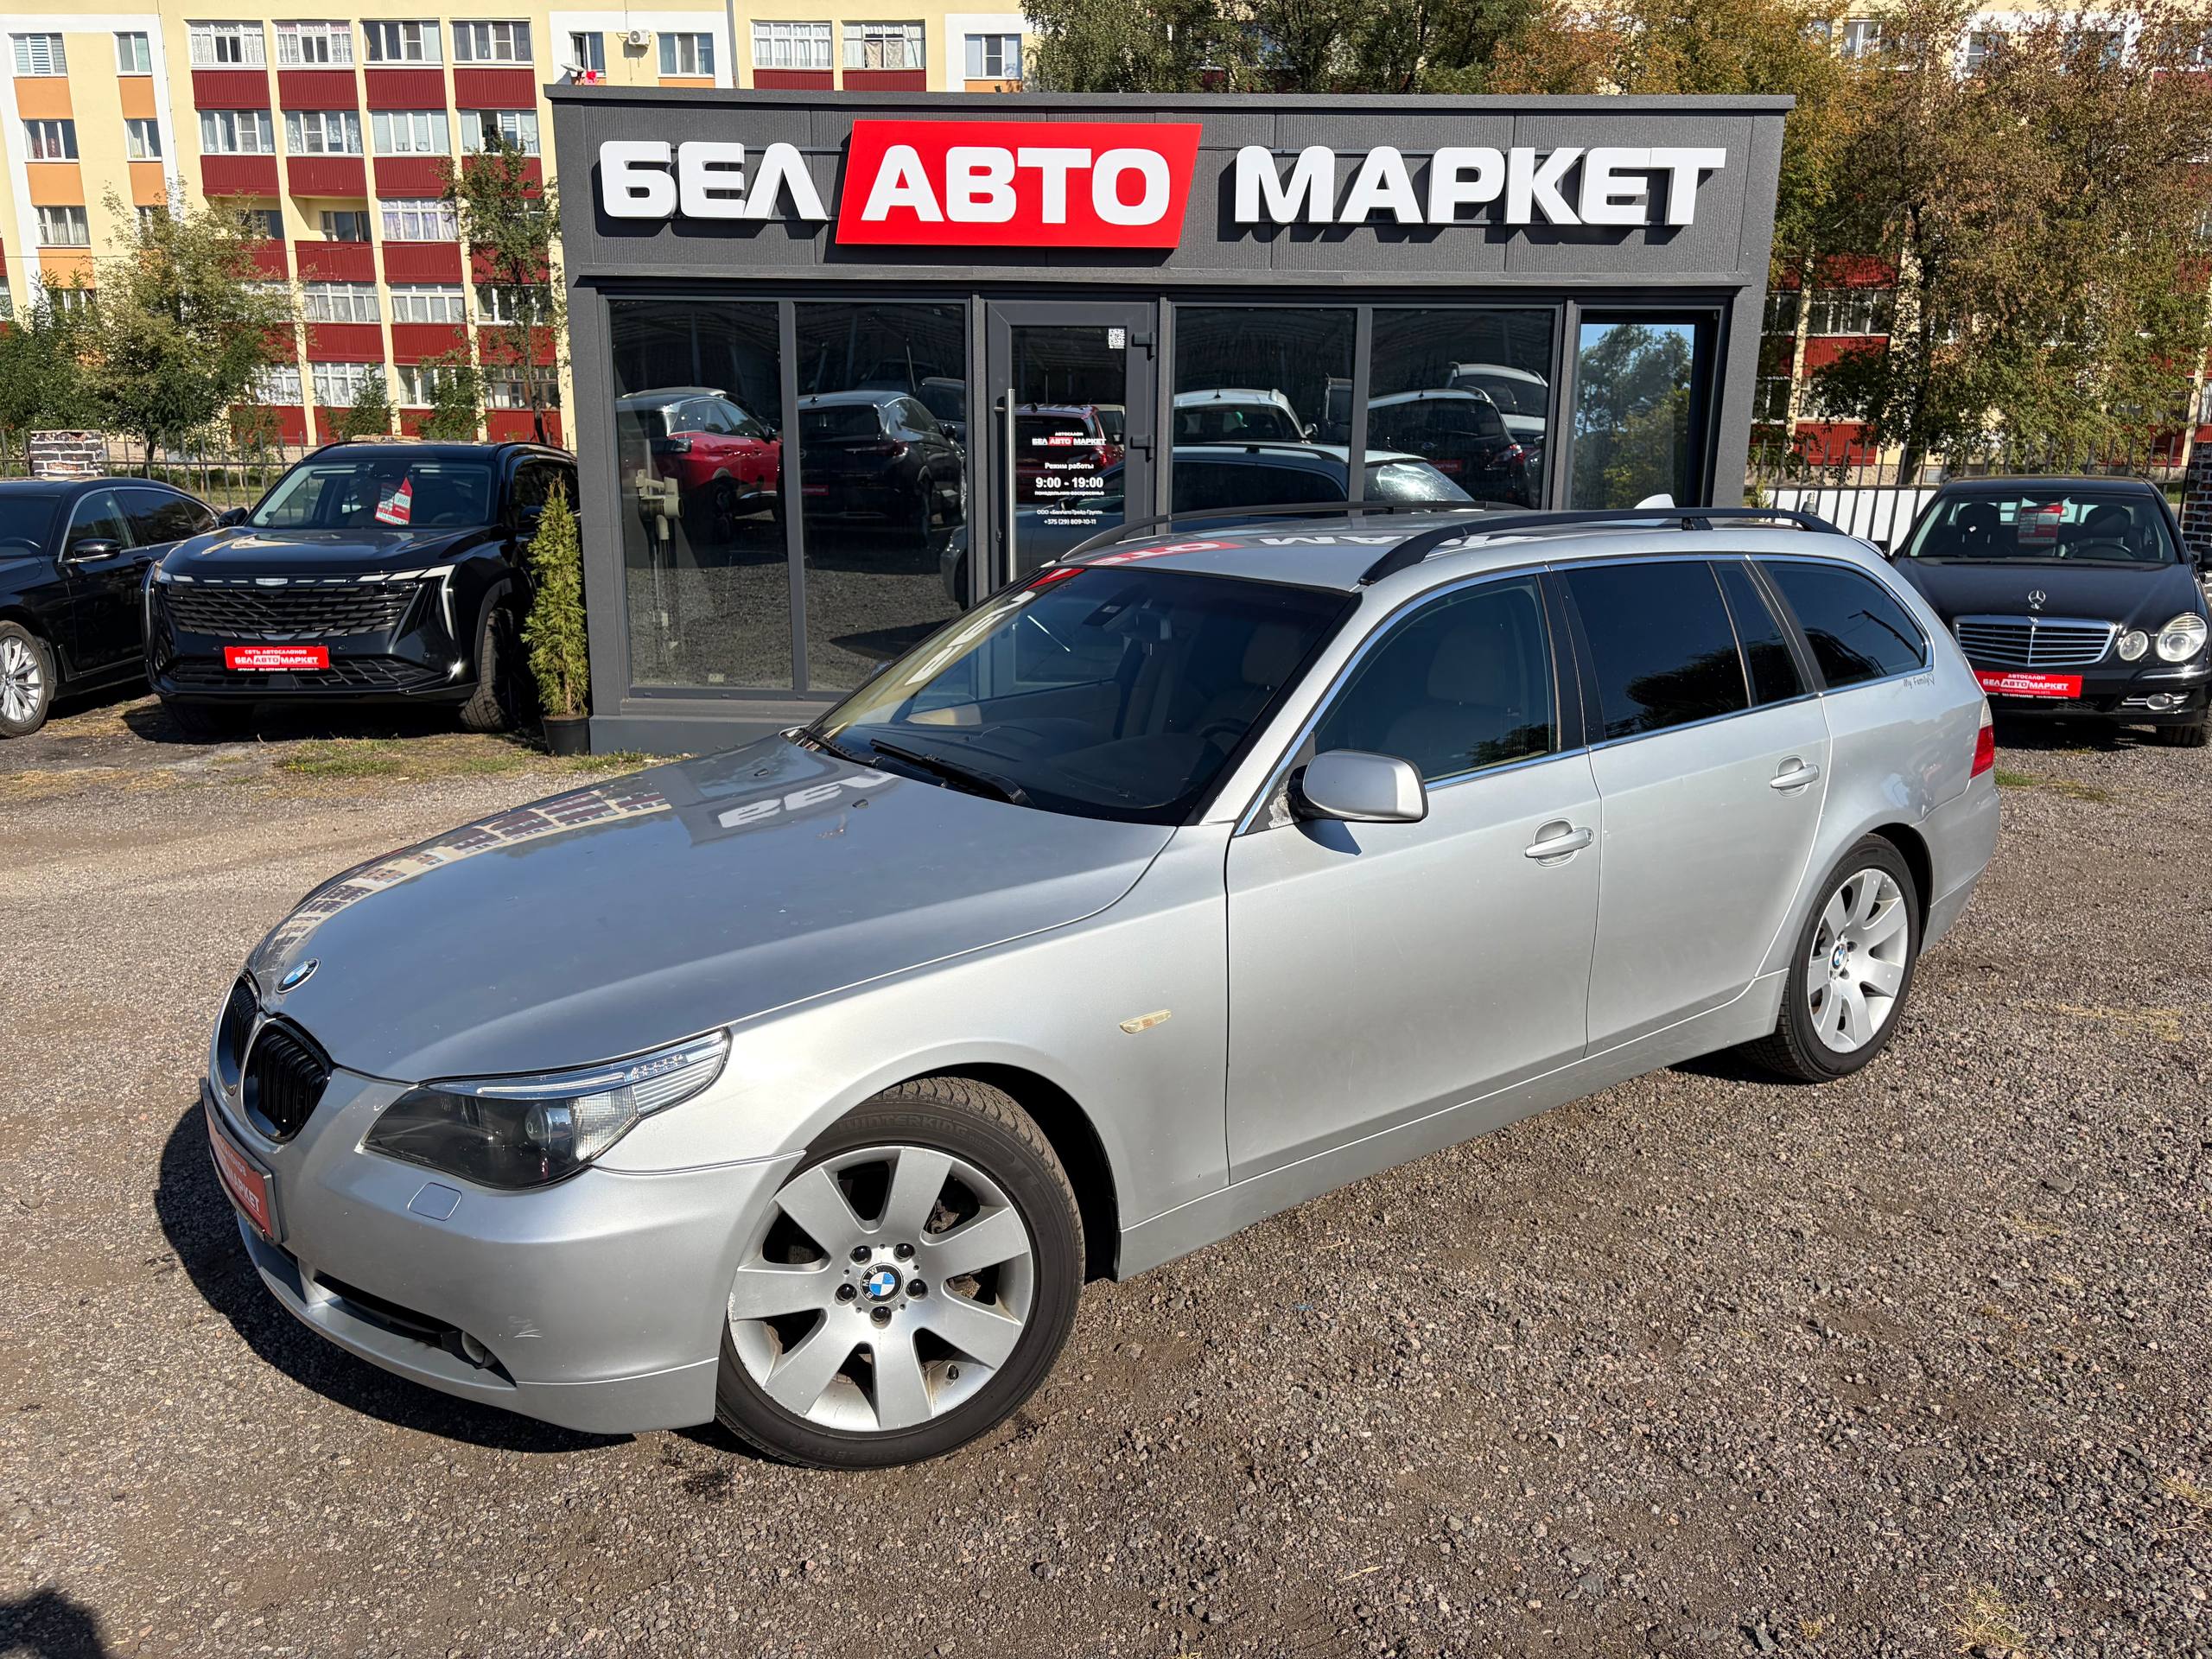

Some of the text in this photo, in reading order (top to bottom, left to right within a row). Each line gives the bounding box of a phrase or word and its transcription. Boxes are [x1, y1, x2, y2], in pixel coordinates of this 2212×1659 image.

[600, 141, 1726, 226] БЕЛ АВТО МАРКЕТ
[1068, 461, 1095, 470] работы
[1035, 477, 1061, 488] 9:00
[1071, 477, 1103, 488] 19:00
[1983, 678, 2000, 687] БЕЛ
[2029, 682, 2069, 690] МАРКЕТ
